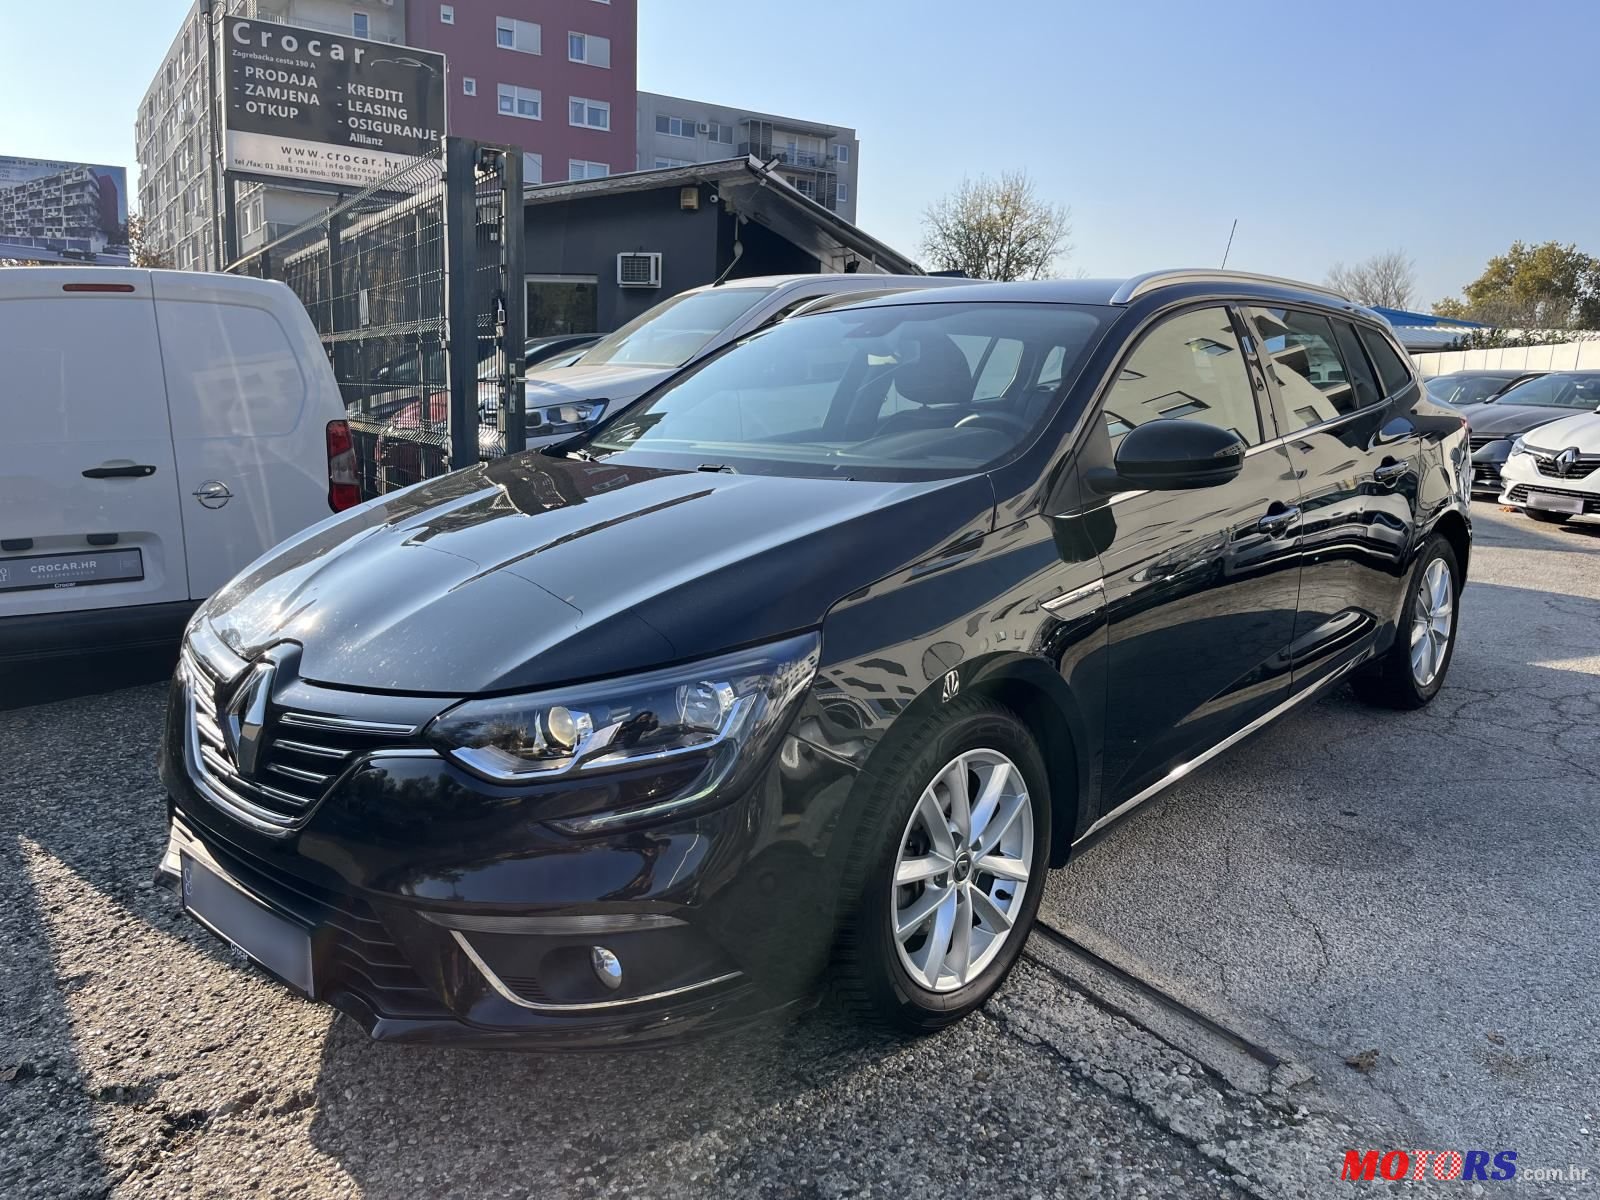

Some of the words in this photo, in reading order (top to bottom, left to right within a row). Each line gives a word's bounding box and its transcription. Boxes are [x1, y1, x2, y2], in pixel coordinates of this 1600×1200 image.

[232, 22, 365, 64] Crocar
[275, 57, 294, 65] cesta
[245, 66, 318, 89] PRODAJA
[245, 83, 320, 106] ZAMJENA
[347, 82, 403, 103] KREDITI
[245, 100, 299, 119] OTKUP
[348, 99, 408, 120] LEASING
[347, 117, 438, 141] OSIGURANJE
[349, 132, 383, 146] Allianz
[281, 146, 400, 168] www.crocar.hr
[31, 561, 97, 573] CROCAR.HR
